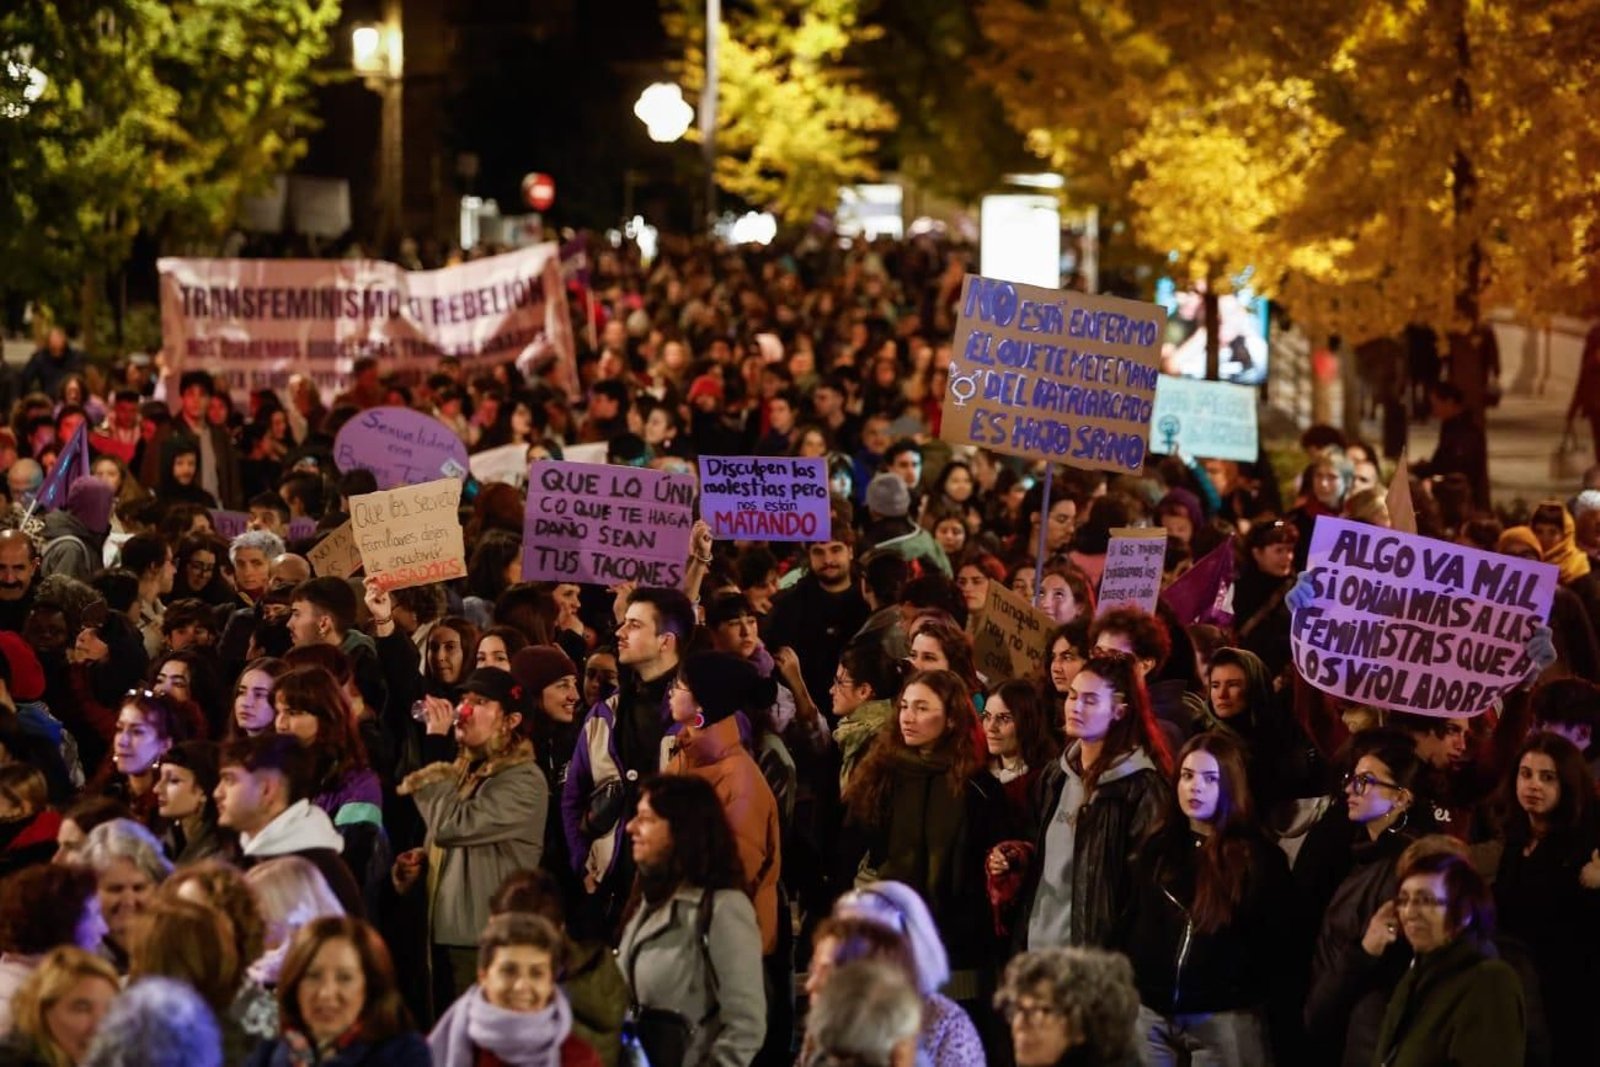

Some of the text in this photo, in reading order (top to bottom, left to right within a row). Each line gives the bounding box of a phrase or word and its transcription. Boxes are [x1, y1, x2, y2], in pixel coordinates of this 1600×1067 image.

[181, 285, 400, 319] TRANSFEMINISMO
[964, 277, 1158, 346] NO ESTÁ ENFERMO
[965, 331, 995, 366] EL
[1115, 358, 1160, 391] MANO
[984, 369, 1027, 407] DEL
[1032, 377, 1152, 423] PATRIARCADO
[969, 408, 1007, 444] ES
[1012, 415, 1071, 455] HIJO
[1071, 425, 1143, 470] SANO
[541, 469, 600, 495] QUE
[609, 476, 642, 499] LO
[707, 459, 816, 481] Disculpen las
[704, 478, 827, 500] molestias pero
[737, 501, 757, 512] nos
[355, 502, 385, 529] Que
[540, 496, 689, 528] CO QUE TE HAGA
[714, 511, 817, 537] MATANDO
[535, 516, 657, 549] DAÑO SEAN
[534, 546, 682, 588] TUS TACONES
[1328, 529, 1540, 611] ALGO VA MAL
[1408, 587, 1475, 628] MÁS
[1471, 605, 1494, 634] A
[1494, 610, 1544, 644] LAS
[1293, 641, 1344, 687] LOS
[1456, 637, 1515, 677] QUE
